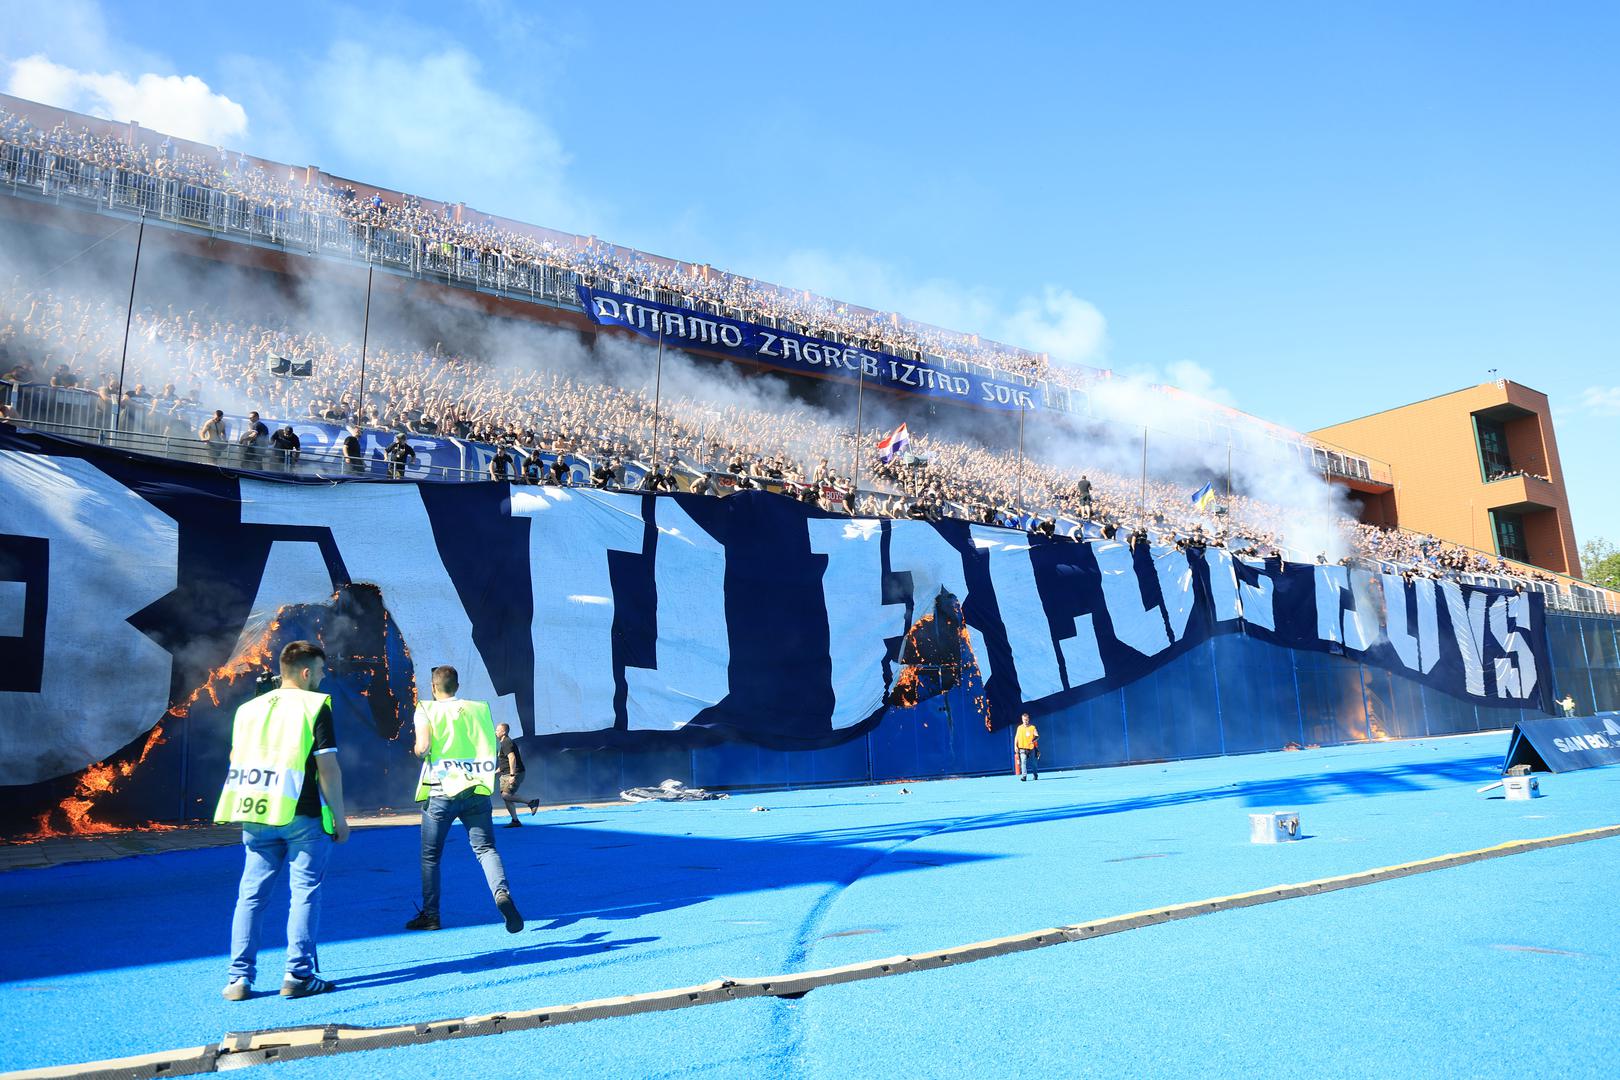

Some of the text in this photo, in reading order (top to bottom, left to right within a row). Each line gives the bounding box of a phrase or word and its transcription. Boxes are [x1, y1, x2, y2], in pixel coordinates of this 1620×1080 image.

[593, 296, 743, 347] DINAMO
[758, 331, 879, 377] ZAGREB
[888, 361, 970, 395] IZNAD
[1553, 736, 1590, 753] SAN
[226, 765, 279, 787] PHOT
[443, 760, 495, 773] PHOTO
[237, 783, 269, 815] 96
